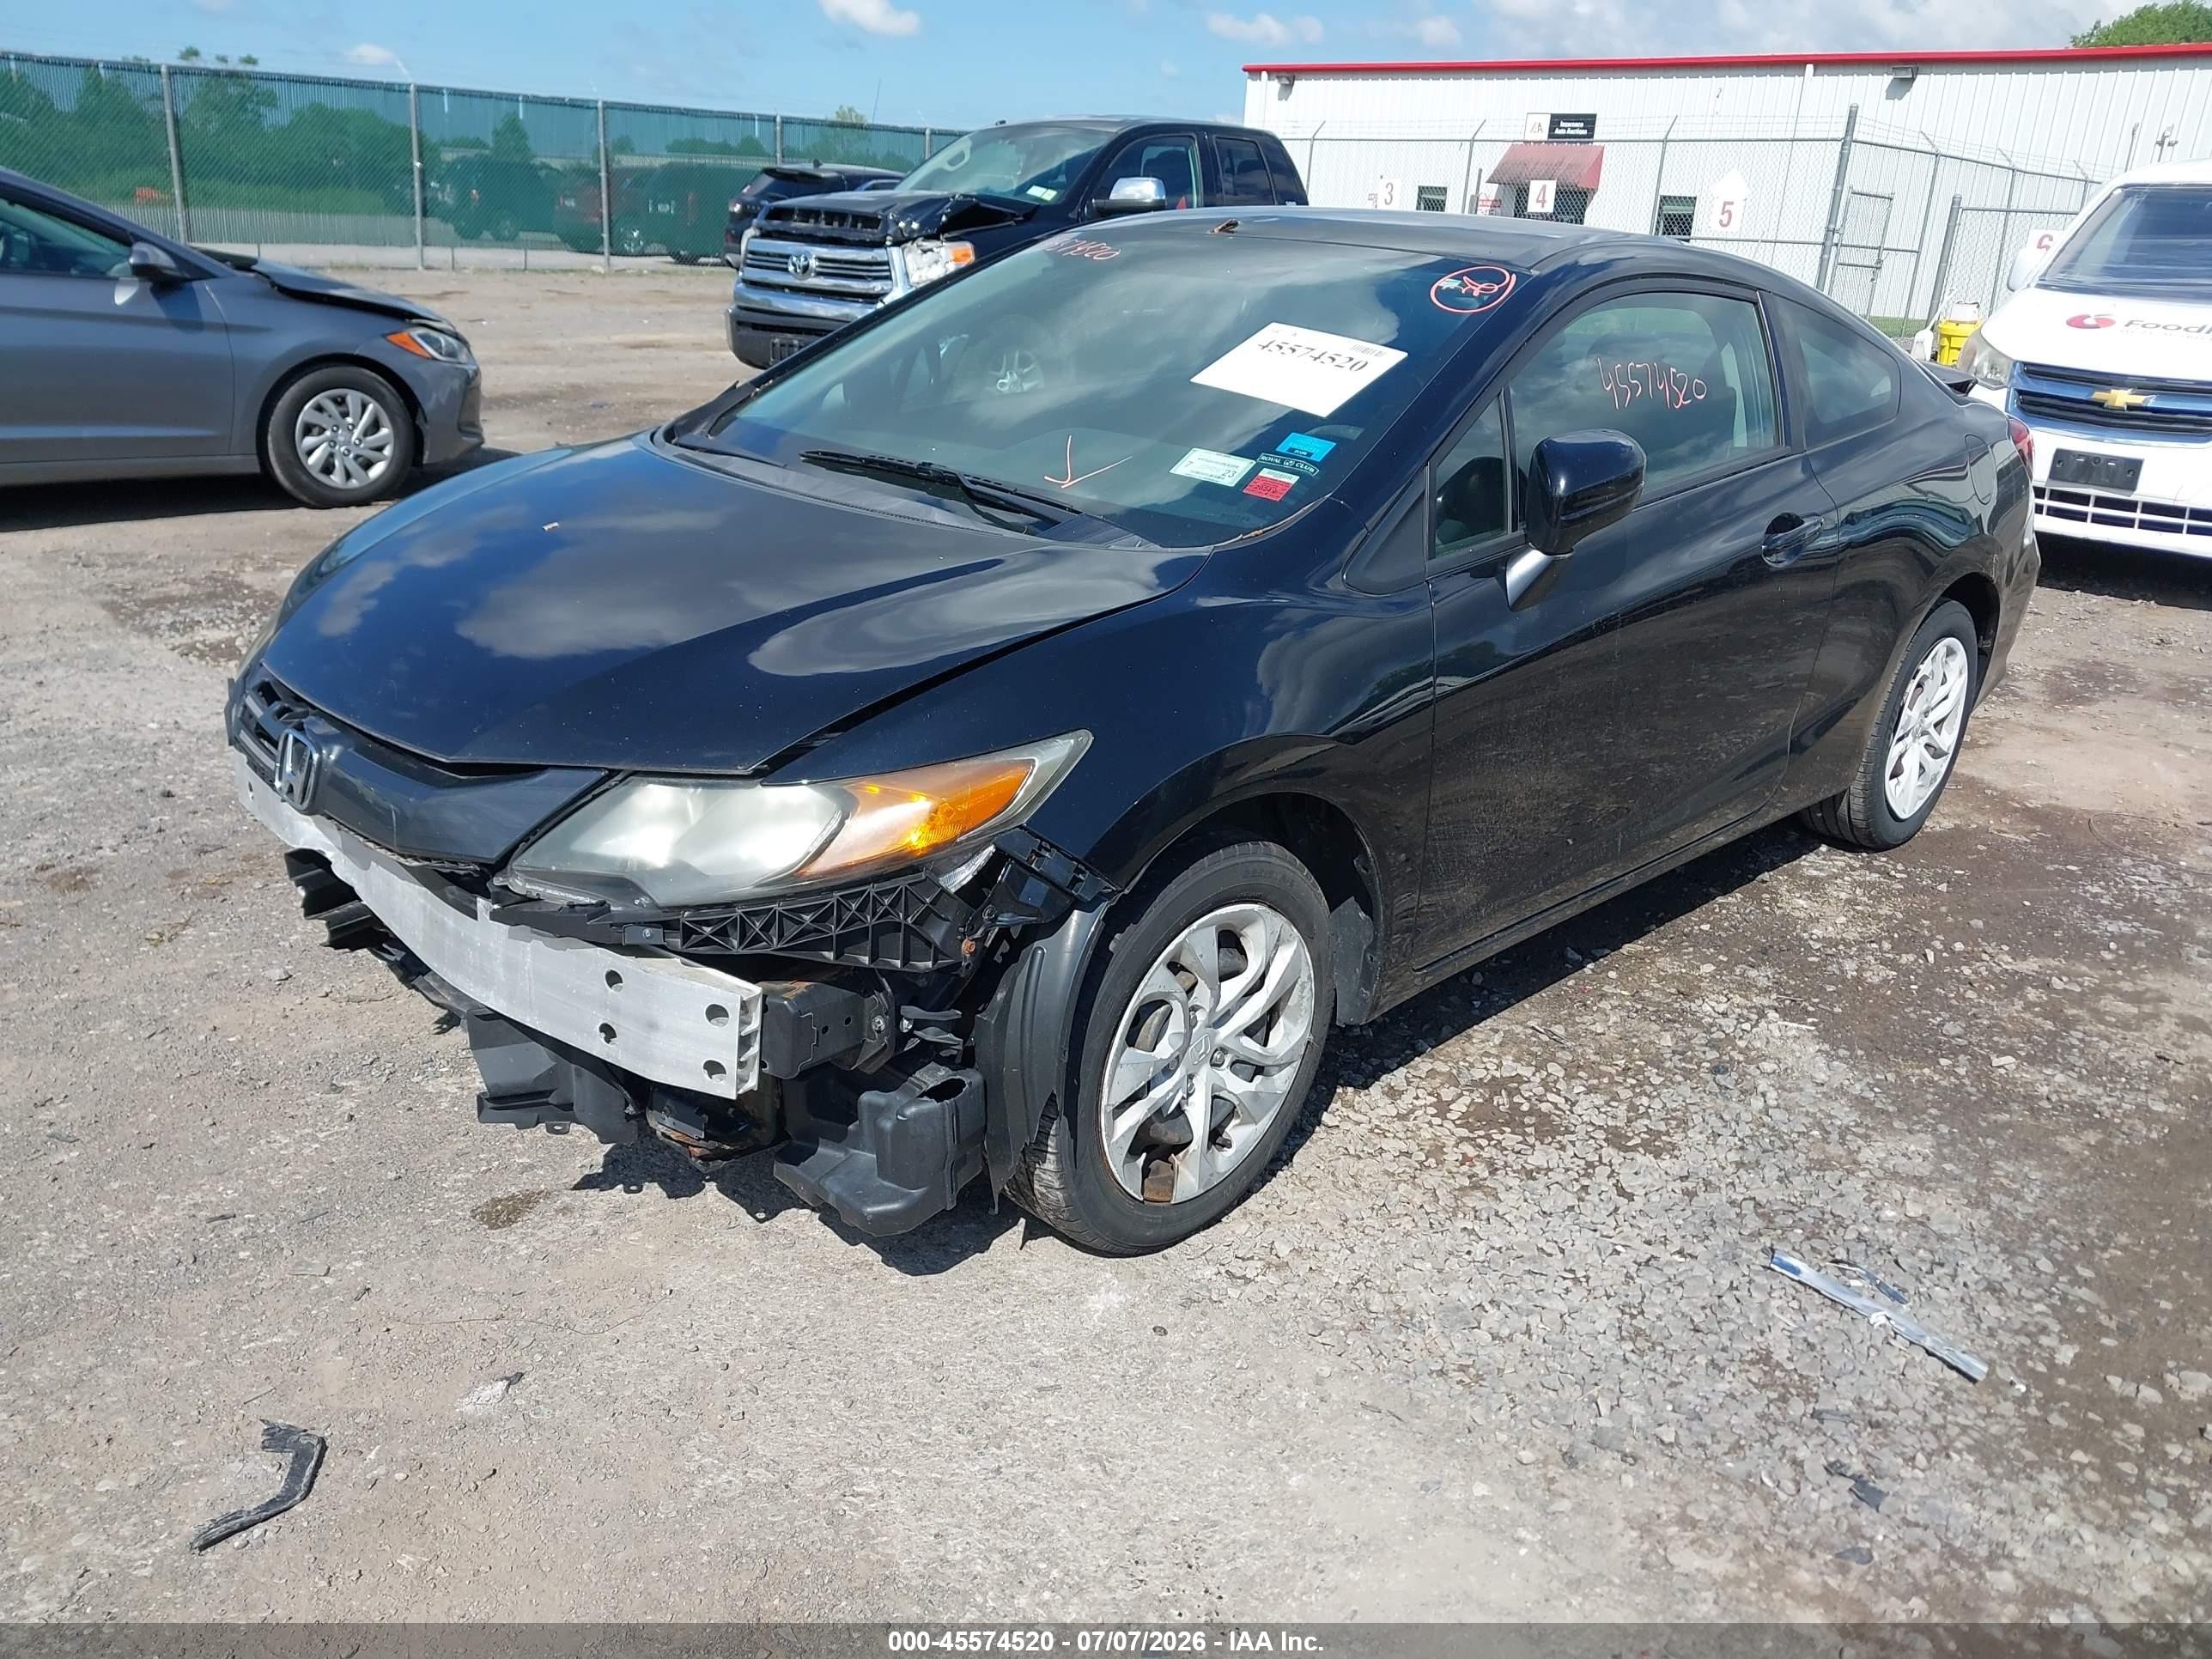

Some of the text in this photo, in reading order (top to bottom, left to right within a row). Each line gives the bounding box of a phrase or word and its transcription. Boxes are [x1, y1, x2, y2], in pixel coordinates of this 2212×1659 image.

[1384, 182, 1394, 205] 3
[1535, 184, 1547, 209] 4
[1718, 200, 1735, 228] 5
[1258, 339, 1369, 372] 45574520
[1596, 356, 1707, 410] 45574520
[1221, 469, 1237, 478] 23
[1261, 455, 1316, 473] ROYAL CLUB
